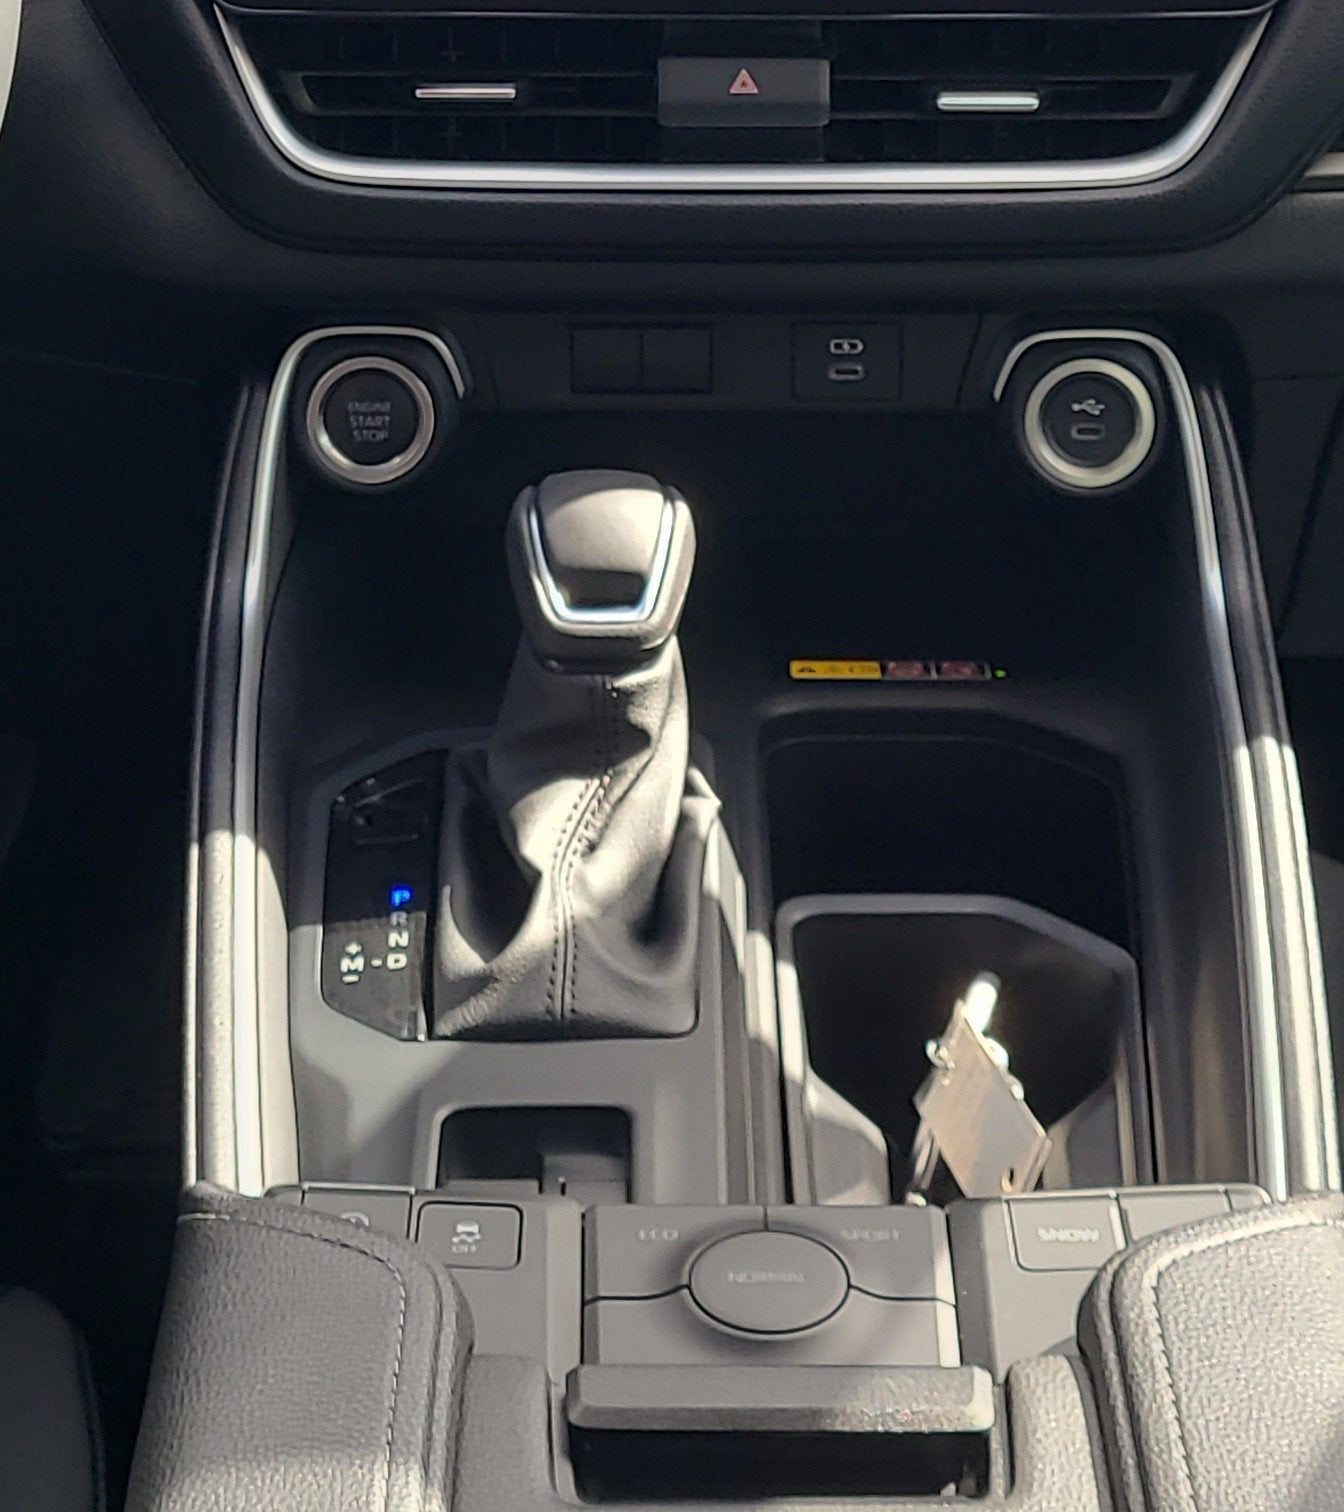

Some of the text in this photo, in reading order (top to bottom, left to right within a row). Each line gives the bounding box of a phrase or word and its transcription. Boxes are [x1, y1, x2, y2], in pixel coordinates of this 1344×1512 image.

[349, 415, 392, 428] START
[352, 429, 389, 442] STOP
[392, 888, 411, 907] P
[390, 911, 408, 927] R
[388, 931, 409, 949] N
[340, 956, 365, 973] M
[386, 953, 407, 970] D
[1036, 1227, 1100, 1243] SNOW
